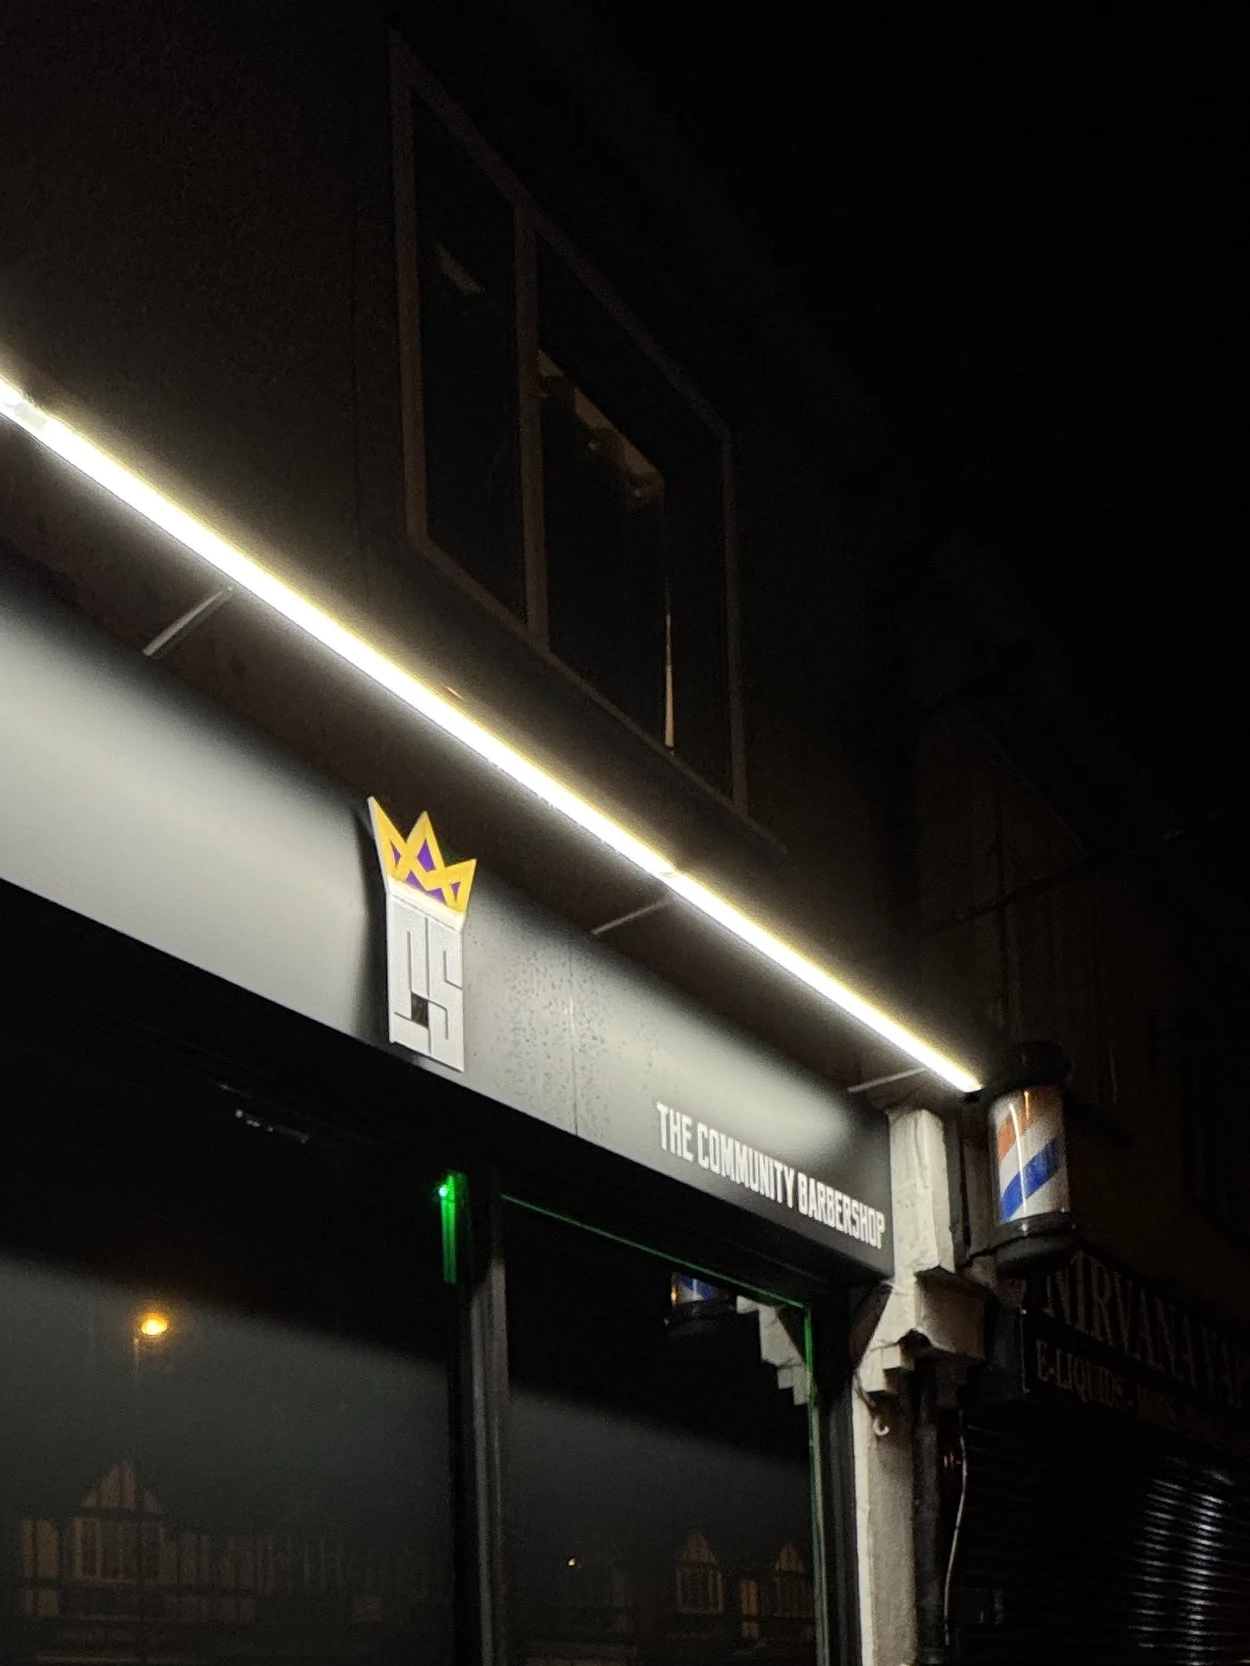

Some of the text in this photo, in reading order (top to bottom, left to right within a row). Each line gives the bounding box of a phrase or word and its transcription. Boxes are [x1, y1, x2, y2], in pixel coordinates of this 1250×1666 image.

[656, 1102, 886, 1249] THE COMMUNITY BARBERSHOP
[1042, 1250, 1198, 1390] NIRVANA
